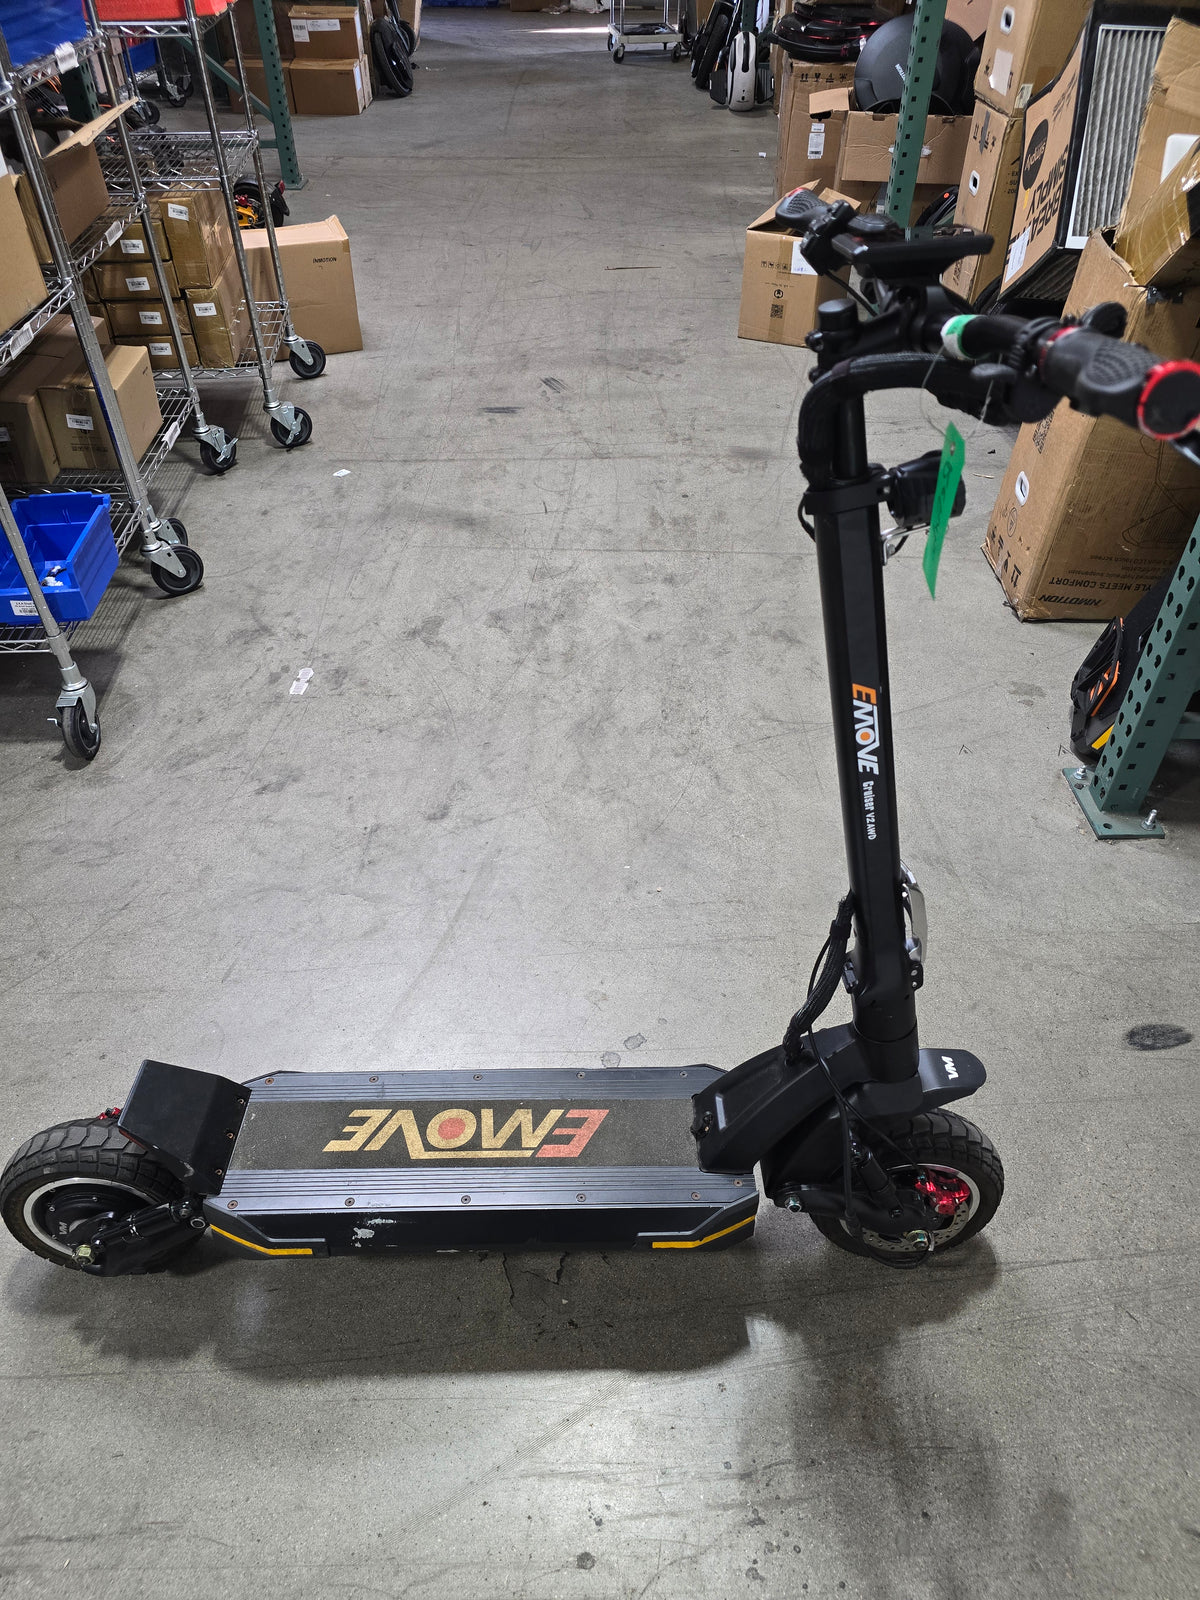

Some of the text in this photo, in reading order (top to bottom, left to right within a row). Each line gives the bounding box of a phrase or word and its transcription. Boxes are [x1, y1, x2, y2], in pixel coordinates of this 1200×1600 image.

[1026, 144, 1069, 221] SIMPLY
[1049, 577, 1097, 589] COMFORT
[1099, 582, 1131, 591] MEETS
[852, 683, 880, 775] EMOVE
[863, 780, 875, 810] Cruiser
[322, 1108, 609, 1160] EMOVE
